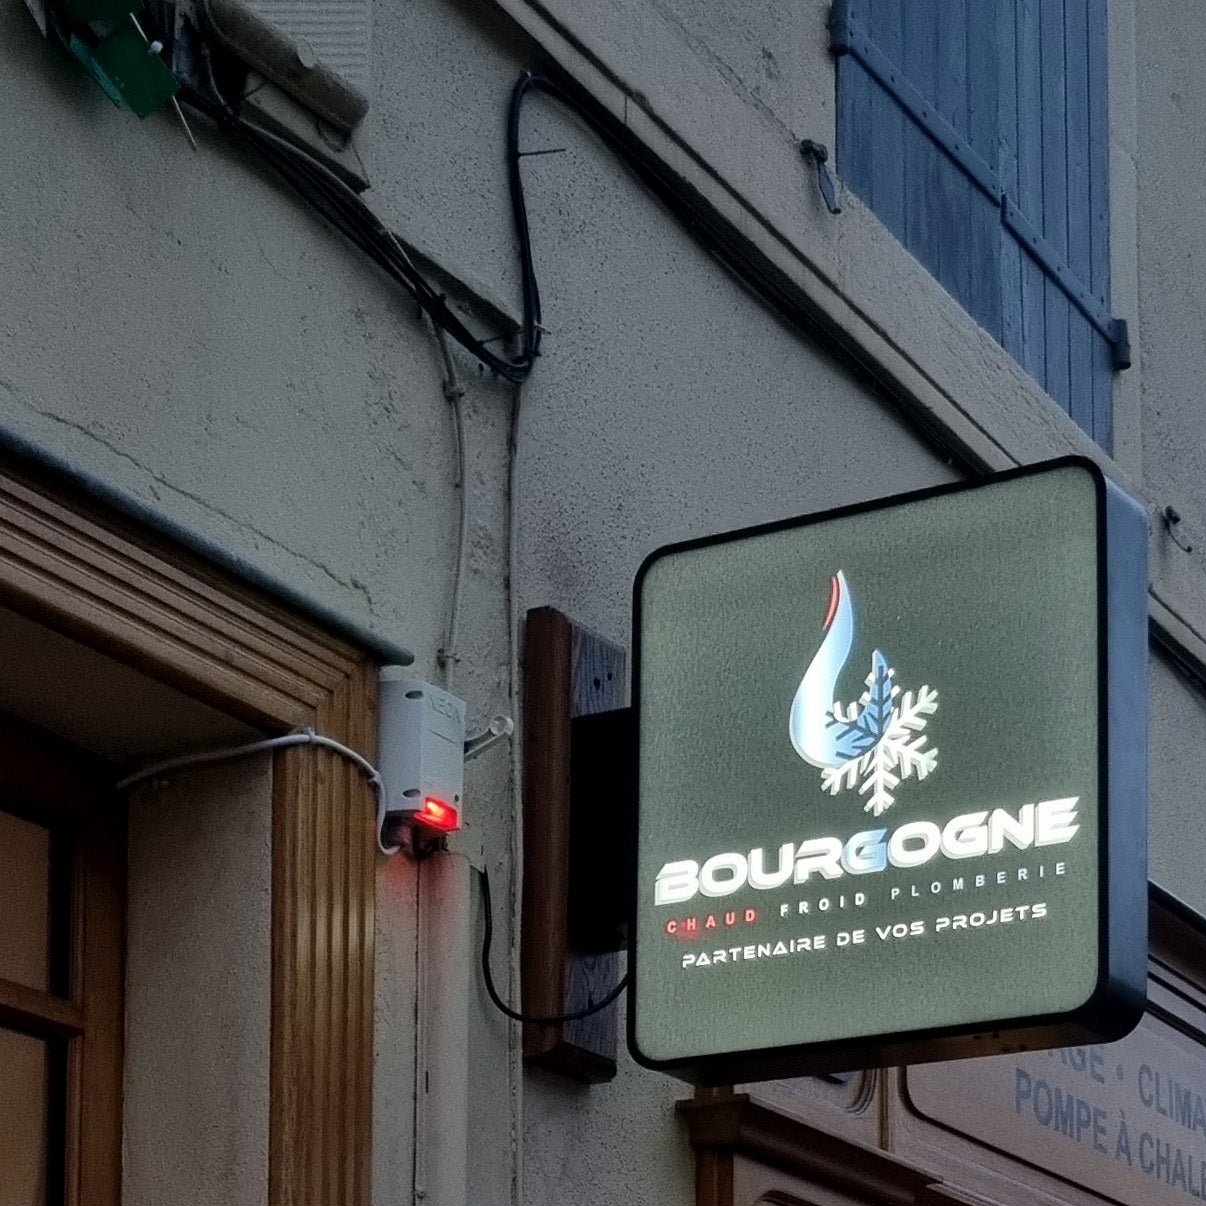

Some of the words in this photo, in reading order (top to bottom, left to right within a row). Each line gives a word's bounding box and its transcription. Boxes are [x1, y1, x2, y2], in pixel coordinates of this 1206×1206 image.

[654, 797, 1080, 906] BOURGOGNE
[667, 909, 756, 933] CHAUD
[779, 893, 866, 917] FROID
[891, 862, 1066, 900] PLOMBERIE
[682, 935, 825, 968] PARTENAIRE
[836, 930, 865, 946] DE
[875, 920, 925, 941] VOS
[935, 902, 1048, 932] PROJETS
[1015, 1066, 1107, 1154] POMPE
[1115, 1109, 1133, 1166] À
